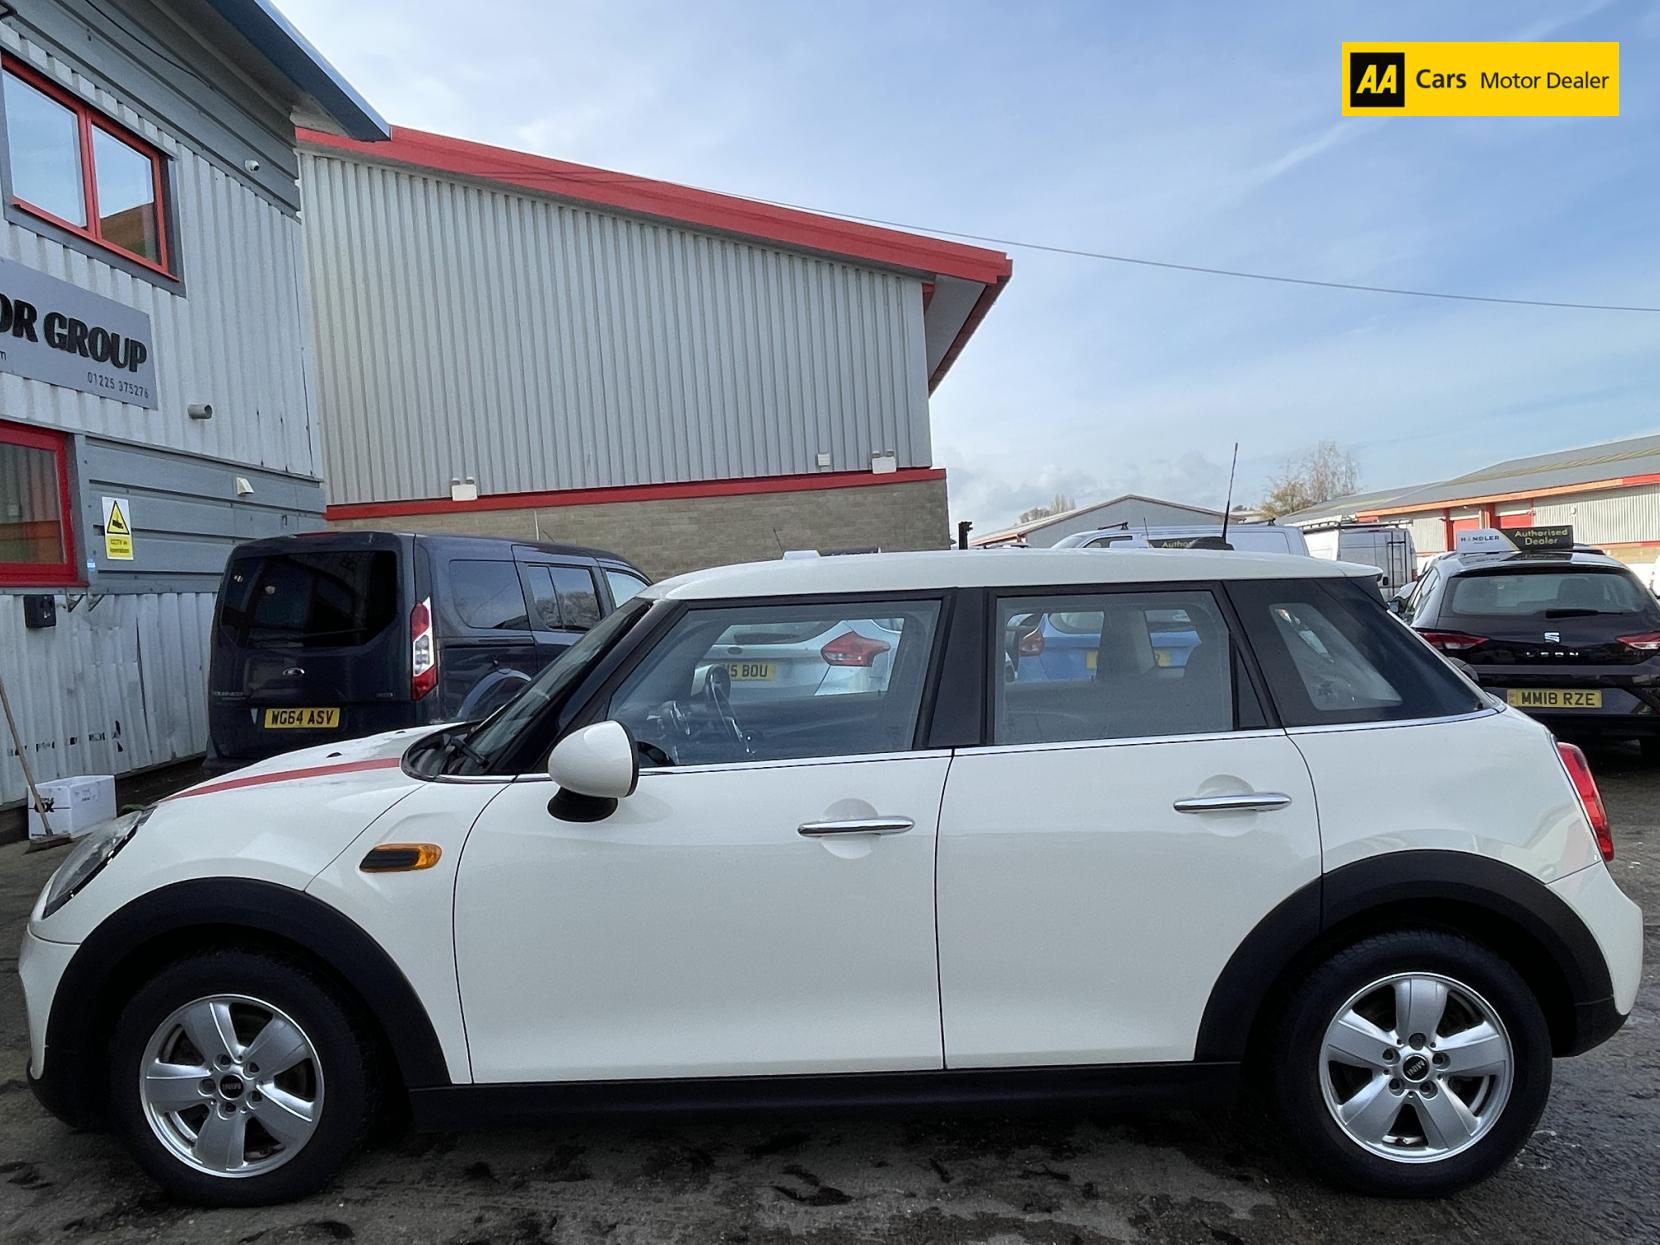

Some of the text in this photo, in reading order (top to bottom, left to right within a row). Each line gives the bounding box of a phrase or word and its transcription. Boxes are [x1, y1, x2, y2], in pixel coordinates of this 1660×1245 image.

[44, 312, 147, 373] GROUP
[87, 371, 115, 390] 01225
[1515, 528, 1568, 538] Authorised
[1525, 537, 1559, 546] Dealer
[742, 664, 768, 678] BOU
[1521, 691, 1595, 706] MM18 RZE
[271, 709, 334, 725] WG64 ASV
